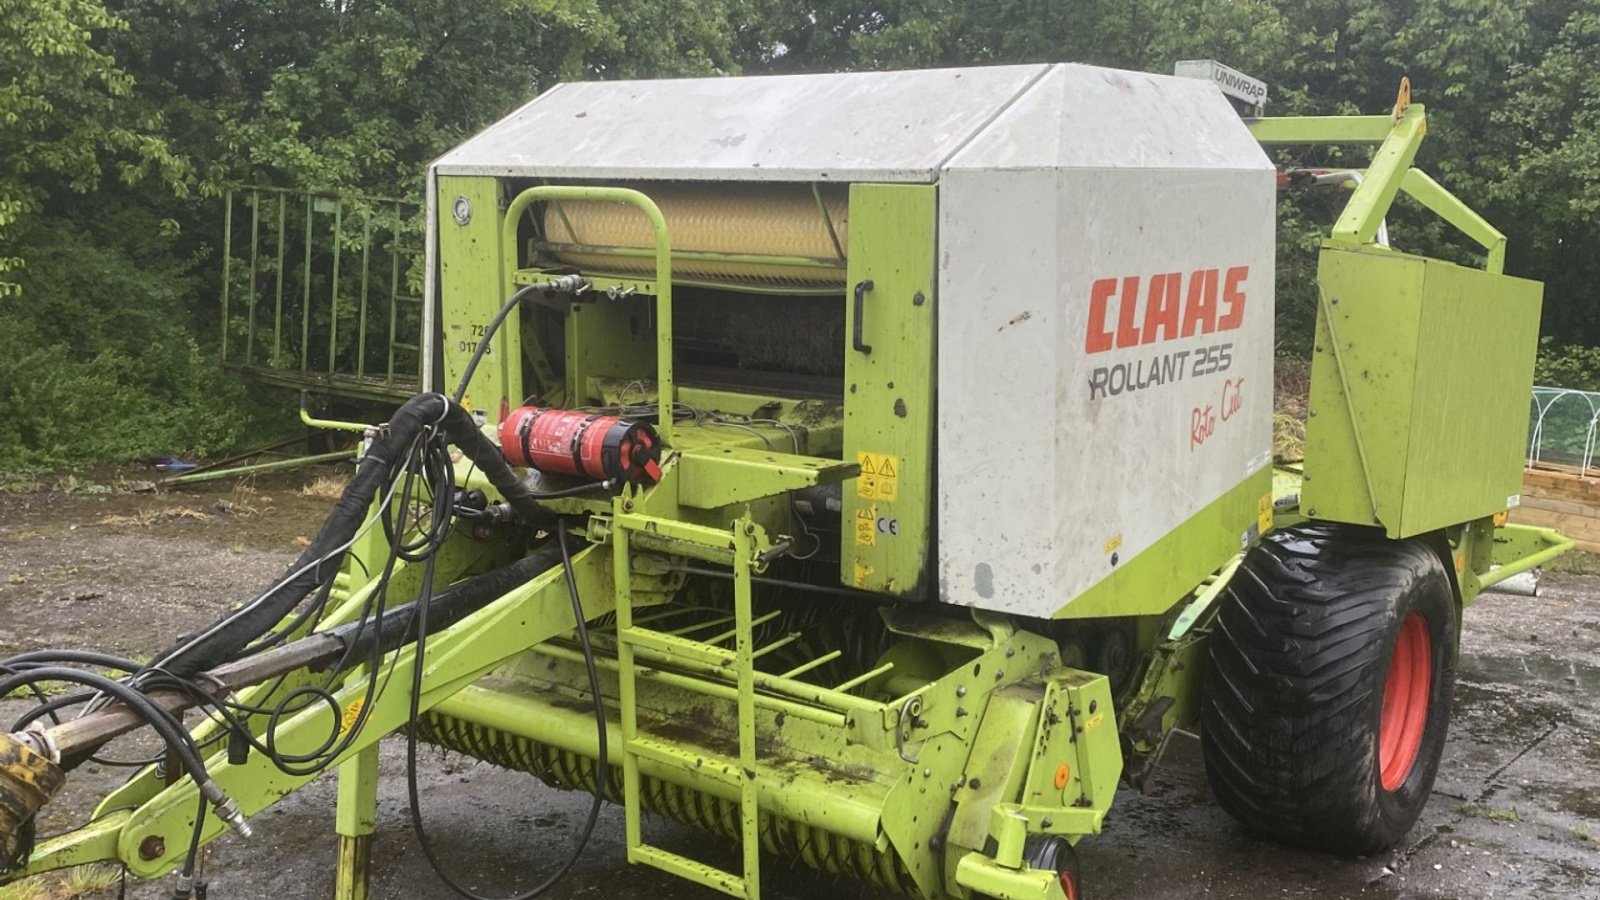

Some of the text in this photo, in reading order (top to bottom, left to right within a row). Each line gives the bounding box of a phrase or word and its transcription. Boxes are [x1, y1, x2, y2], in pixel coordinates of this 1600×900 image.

[1215, 68, 1265, 98] UNIWRAP
[1085, 266, 1249, 354] CLAAS
[460, 341, 491, 355] 0176
[1090, 343, 1233, 400] ROLLANT 255
[1190, 376, 1244, 452] Roto Cut
